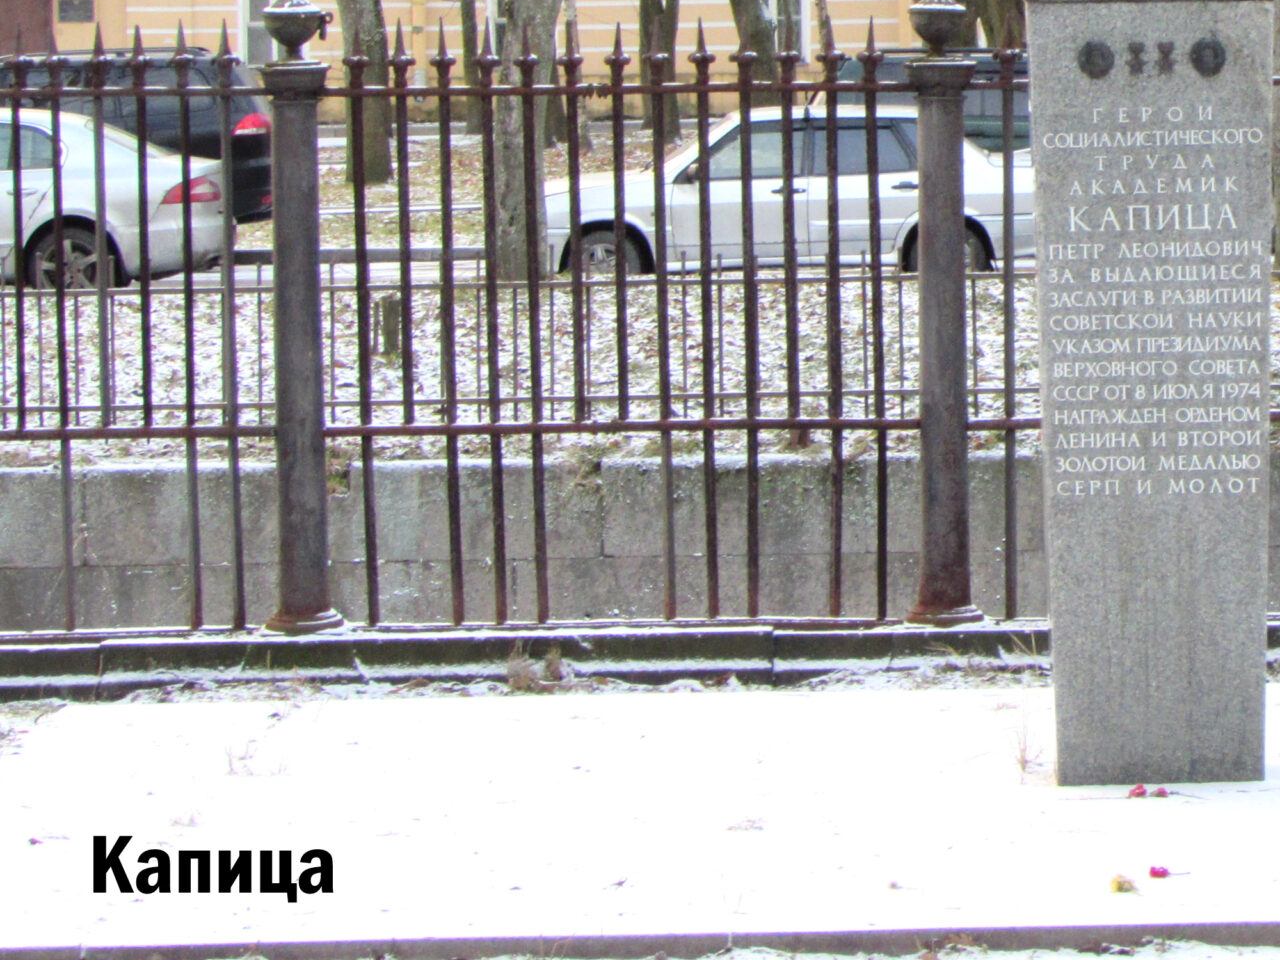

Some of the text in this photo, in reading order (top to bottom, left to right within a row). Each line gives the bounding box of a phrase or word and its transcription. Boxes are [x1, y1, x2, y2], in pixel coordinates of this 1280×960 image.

[1043, 128, 1263, 149] СОЦИАЛИСТИЧЕСКОГО
[1094, 153, 1214, 171] ТРУДА
[1070, 176, 1239, 195] АКАДЕМИК
[1069, 203, 1238, 232] КАПИЦА
[1049, 240, 1263, 260] ПЕТР ЛЕОНИДОВИЧ
[1048, 264, 1262, 284] ЗА ВЫДАЮЩИЕСЯ
[1049, 288, 1262, 308] ЗАСЛУГИ В РАЗВИТИИ
[1188, 311, 1261, 329] НАУКИ
[1052, 336, 1262, 355] УКАЗОМ ПРЕЗИДИУМА
[1054, 359, 1261, 378] ВЕРХОВНОГО СОВЕТА
[1053, 383, 1261, 401] СССР ОТ 8 ИЮЛЯ 1974
[1054, 407, 1261, 425] НАГРАЖДЕН ОРДЕНОМ
[1055, 432, 1141, 449] ЛЕНИНА
[1152, 432, 1165, 447] И
[1158, 454, 1261, 471] МЕДАЛЬЮ
[1057, 477, 1260, 496] СЕРП И МОЛОТ
